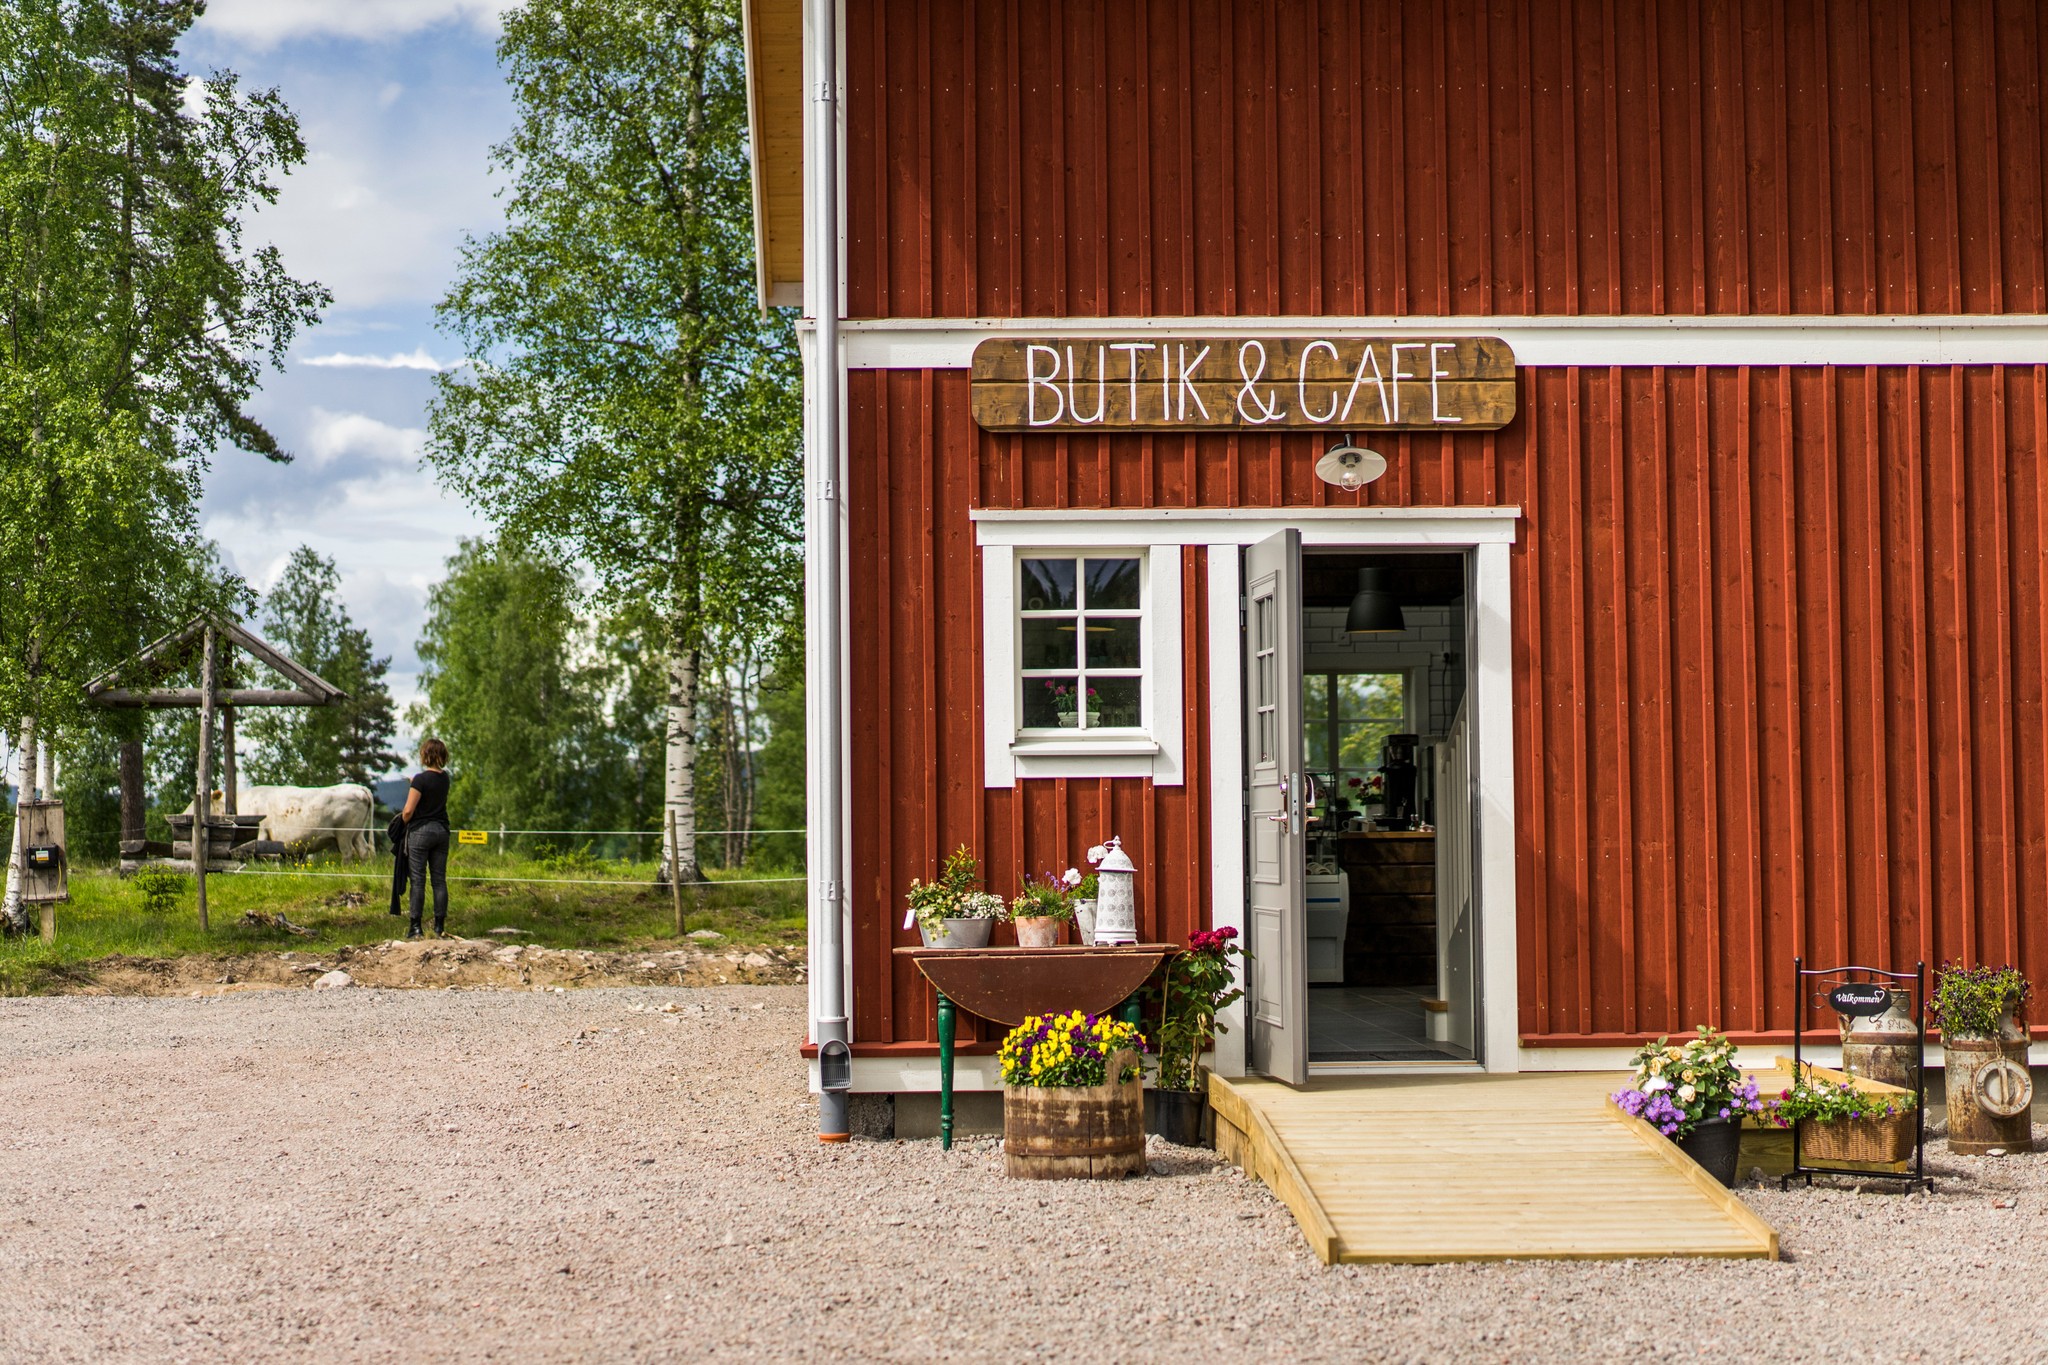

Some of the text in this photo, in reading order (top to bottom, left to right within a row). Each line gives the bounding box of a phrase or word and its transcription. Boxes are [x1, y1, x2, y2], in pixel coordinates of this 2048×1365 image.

[1026, 340, 1463, 427] BUTIK & CAFE
[1835, 991, 1881, 1005] Välkommen
